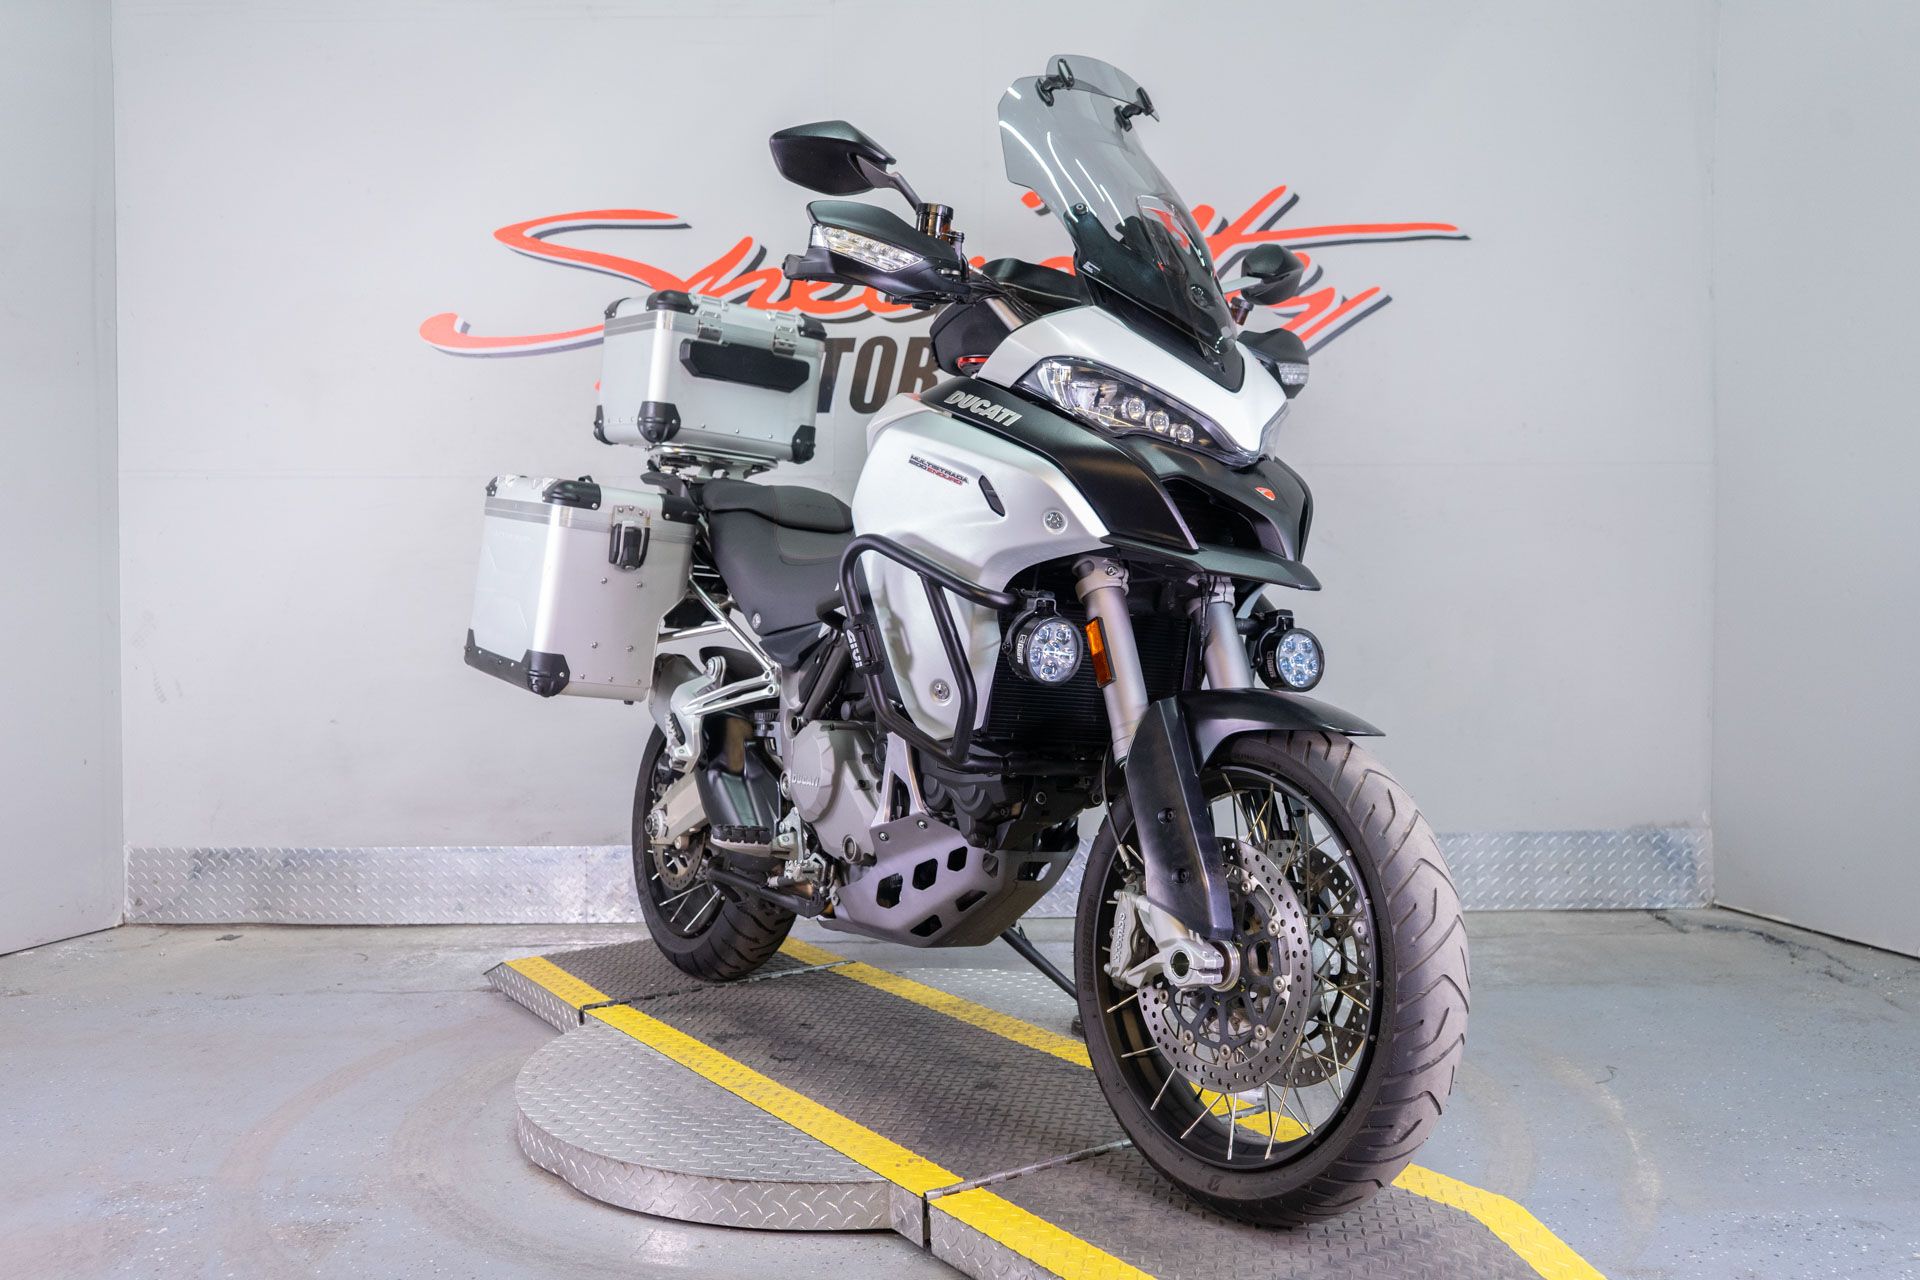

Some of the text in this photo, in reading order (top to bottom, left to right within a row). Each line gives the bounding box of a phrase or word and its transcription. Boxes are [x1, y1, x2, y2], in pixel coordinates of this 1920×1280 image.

[943, 390, 1023, 427] DUCATI
[846, 629, 863, 668] GIVI
[791, 774, 820, 787] DUCATI
[1113, 912, 1126, 963] brembo
